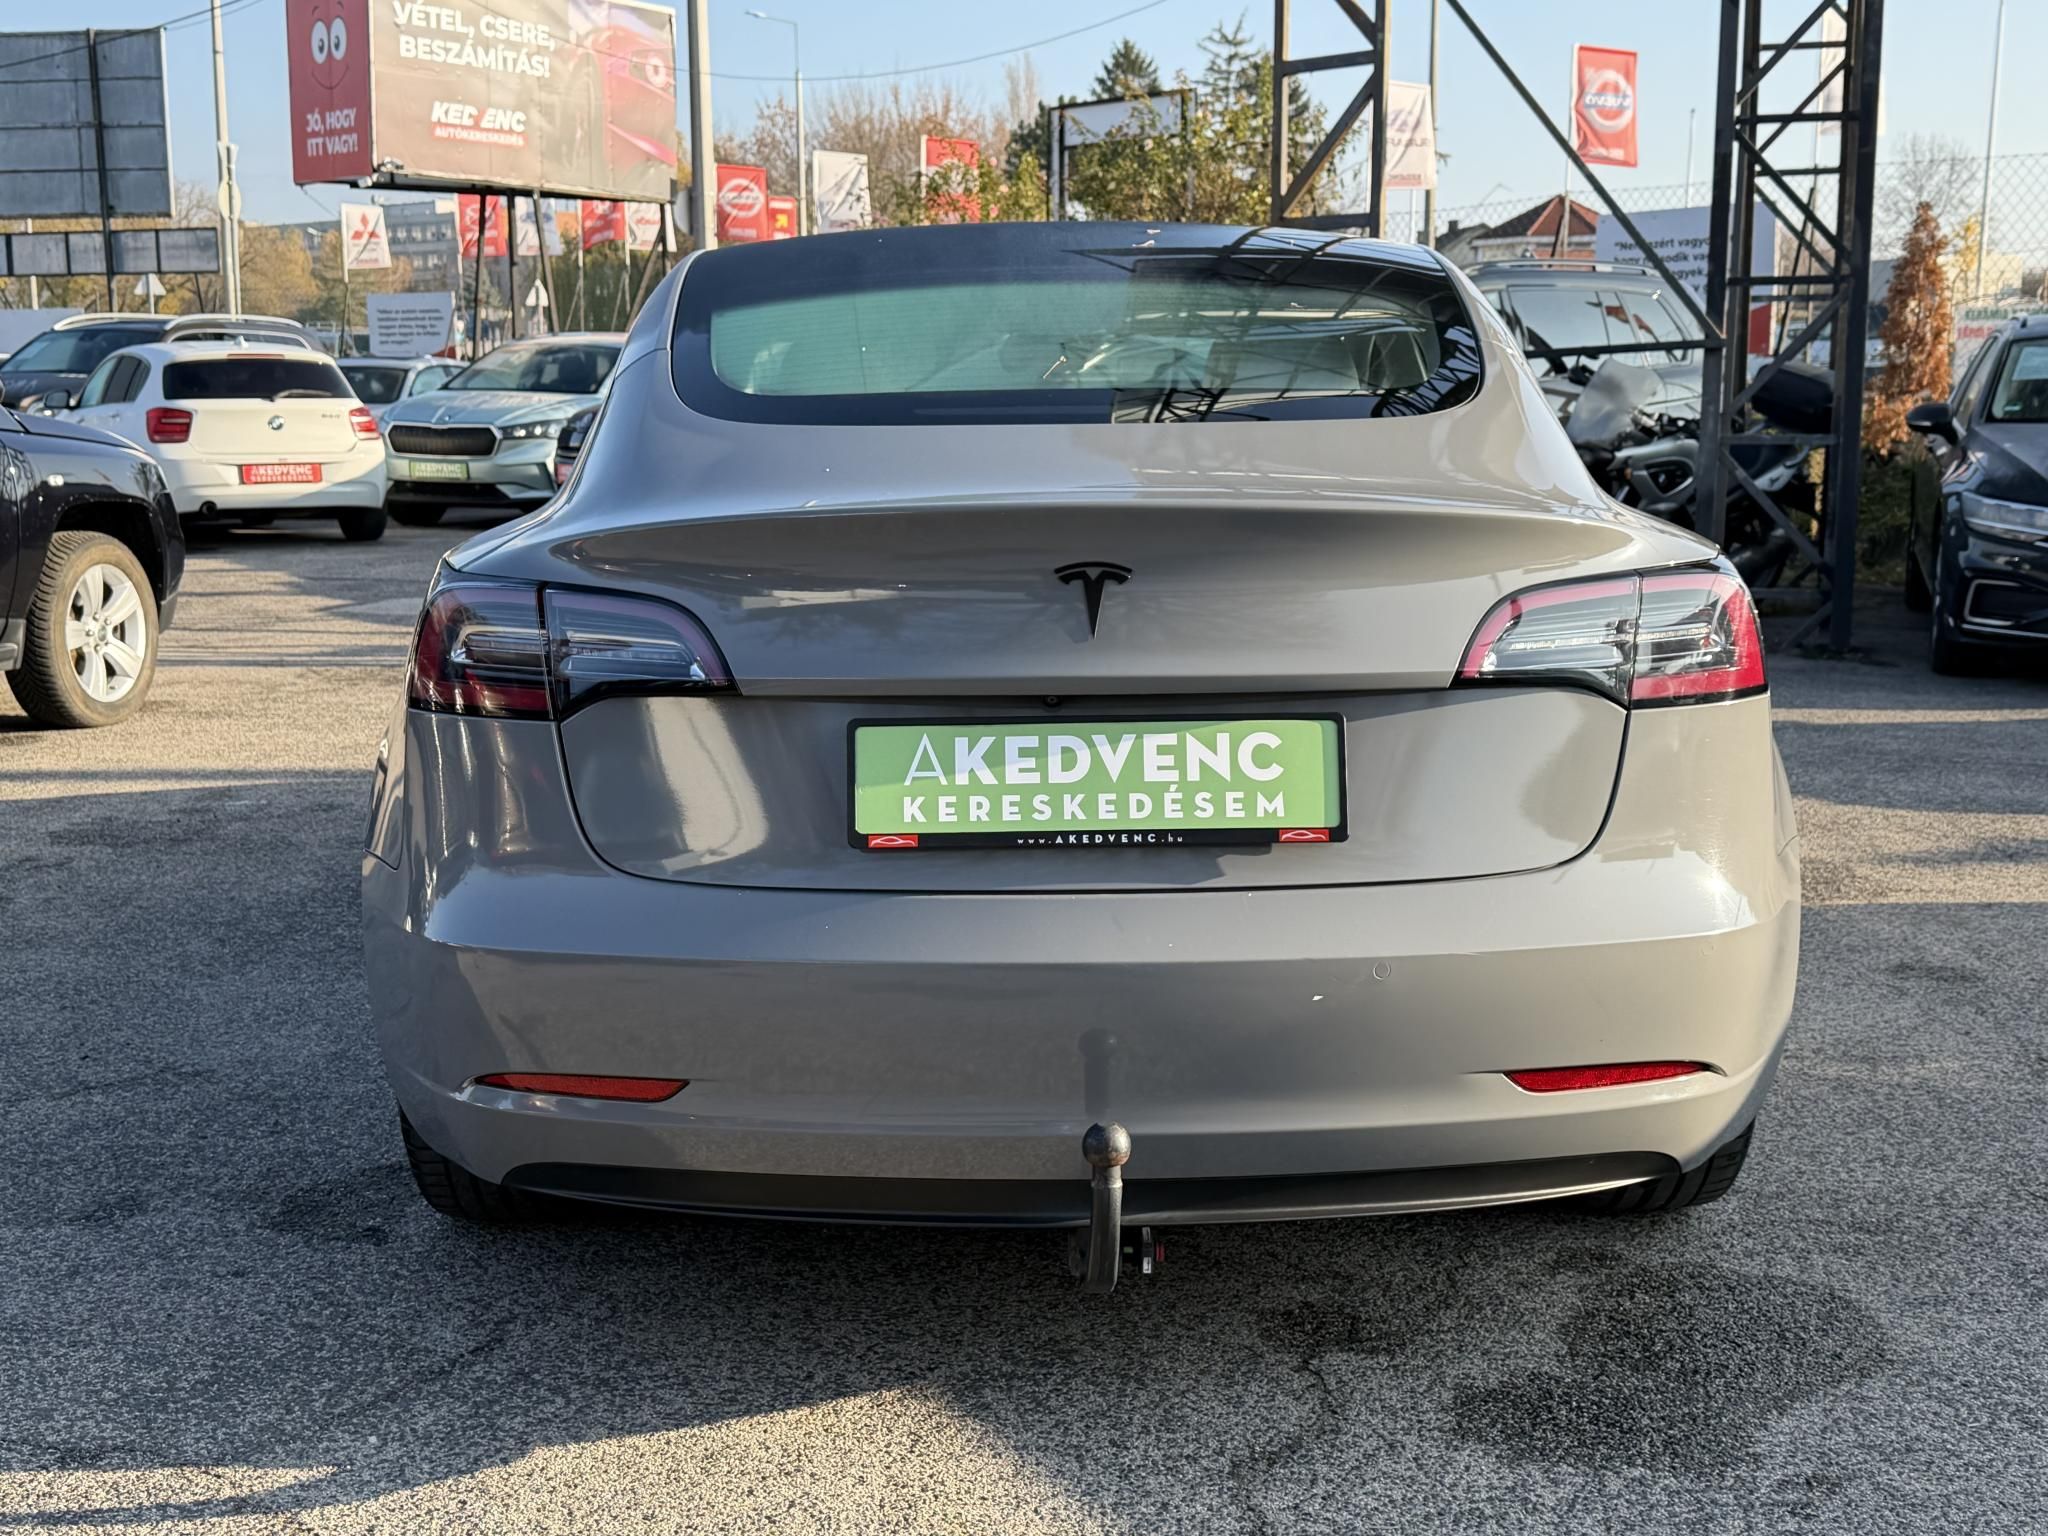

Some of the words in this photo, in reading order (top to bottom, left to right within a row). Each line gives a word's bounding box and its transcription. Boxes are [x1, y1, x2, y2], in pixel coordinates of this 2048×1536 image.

[392, 0, 475, 38] VÉTEL,
[479, 14, 556, 51] CSERE,
[399, 34, 551, 78] BESZÁMÍTÁS!
[306, 107, 324, 134] JÓ,
[325, 107, 357, 131] HOGY
[307, 137, 324, 157] ITT
[325, 133, 358, 155] VAGY!
[903, 731, 1284, 786] AKEDVENC
[903, 784, 1286, 823] KERESKEDÉSEM
[1017, 833, 1183, 845] www.AKEDVENC.hu
